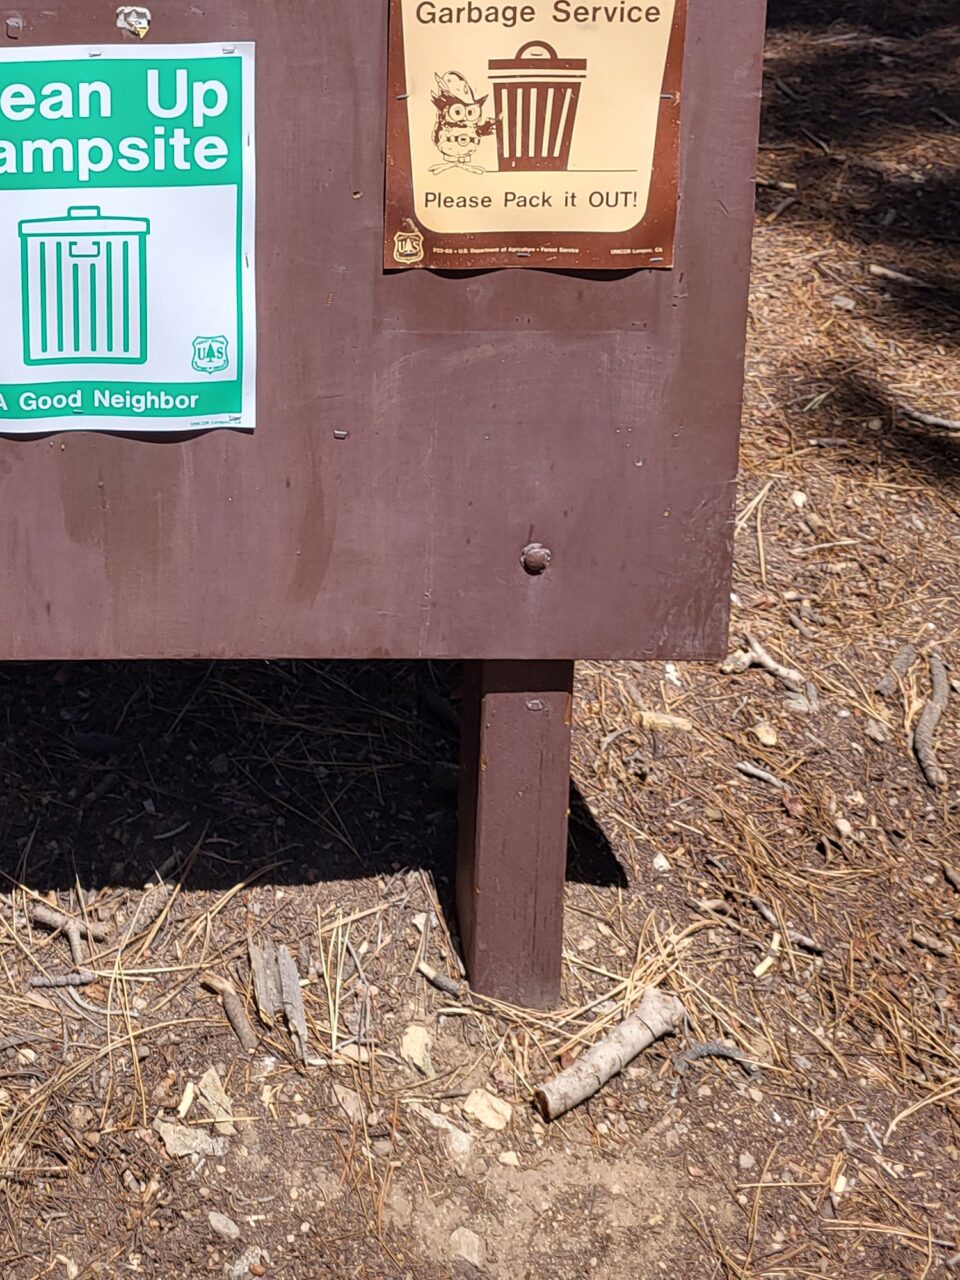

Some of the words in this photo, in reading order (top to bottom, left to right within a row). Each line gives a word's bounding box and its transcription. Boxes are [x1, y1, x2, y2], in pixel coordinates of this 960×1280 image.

[416, 1, 536, 28] Garbage
[552, 0, 661, 24] Service
[147, 68, 229, 127] Up
[424, 191, 492, 208] Please
[504, 191, 552, 208] Pack
[564, 192, 576, 208] it
[588, 191, 638, 208] OUT!
[18, 389, 82, 411] Good
[93, 389, 200, 413] Neighbor
